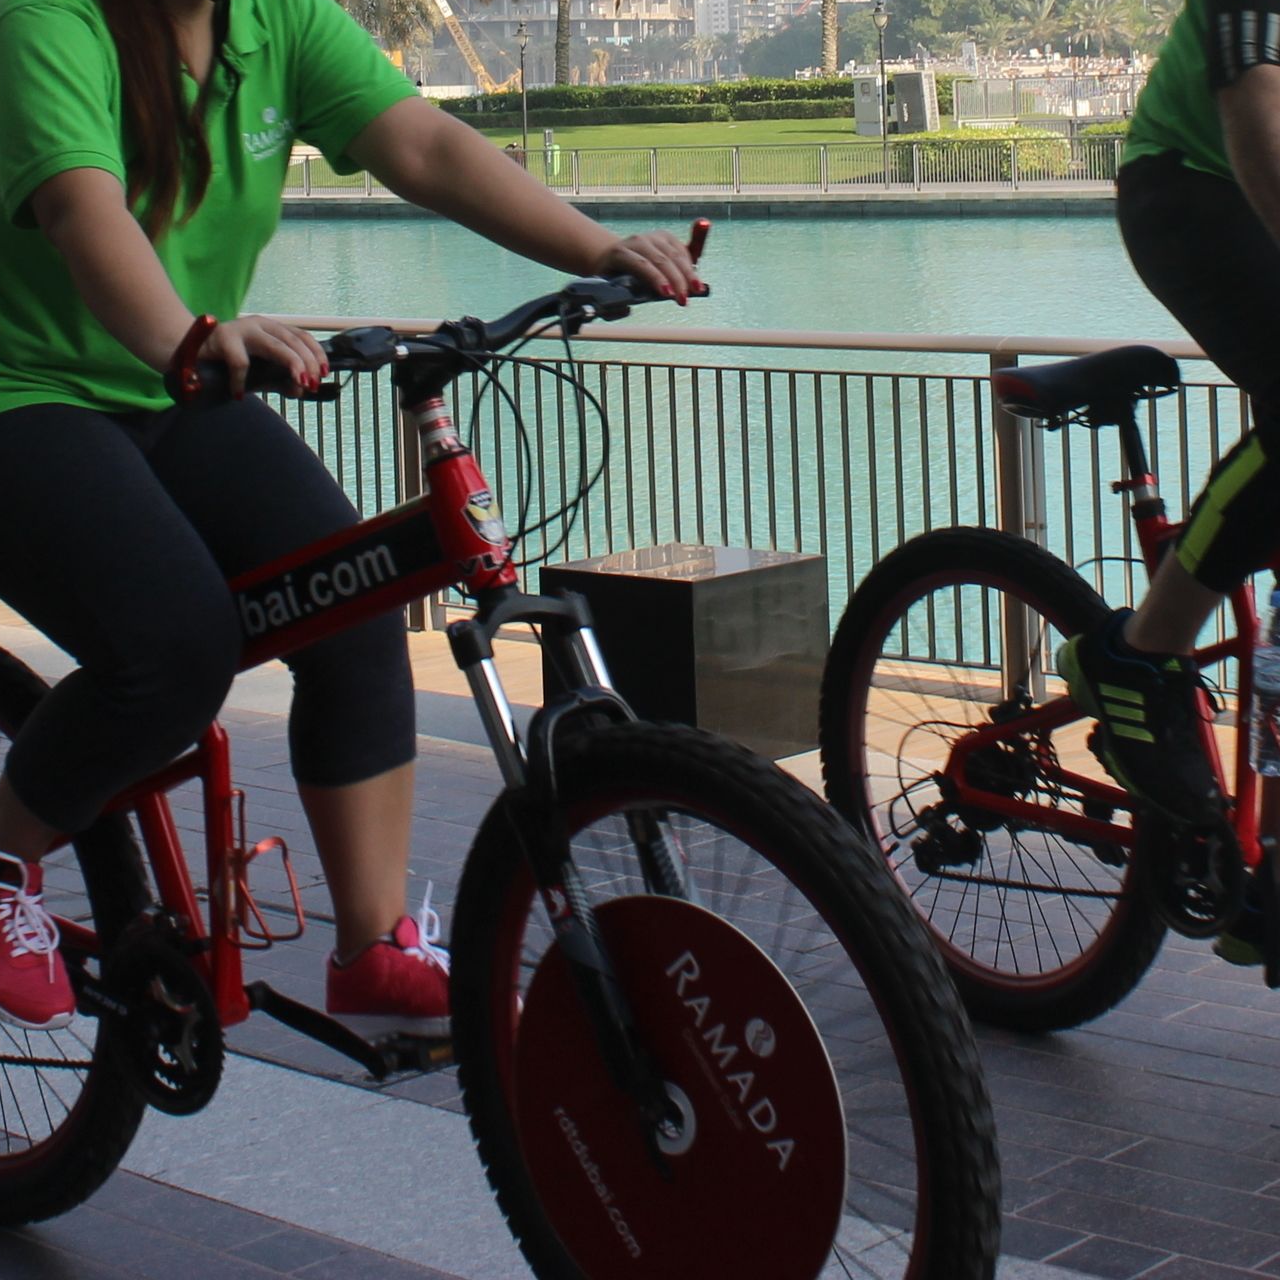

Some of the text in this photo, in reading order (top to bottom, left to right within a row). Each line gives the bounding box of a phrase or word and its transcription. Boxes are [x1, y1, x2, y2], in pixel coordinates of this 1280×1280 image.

[238, 543, 398, 638] bai.com
[665, 949, 795, 1172] RAMADA
[553, 1105, 642, 1259] rdtdubai.com
